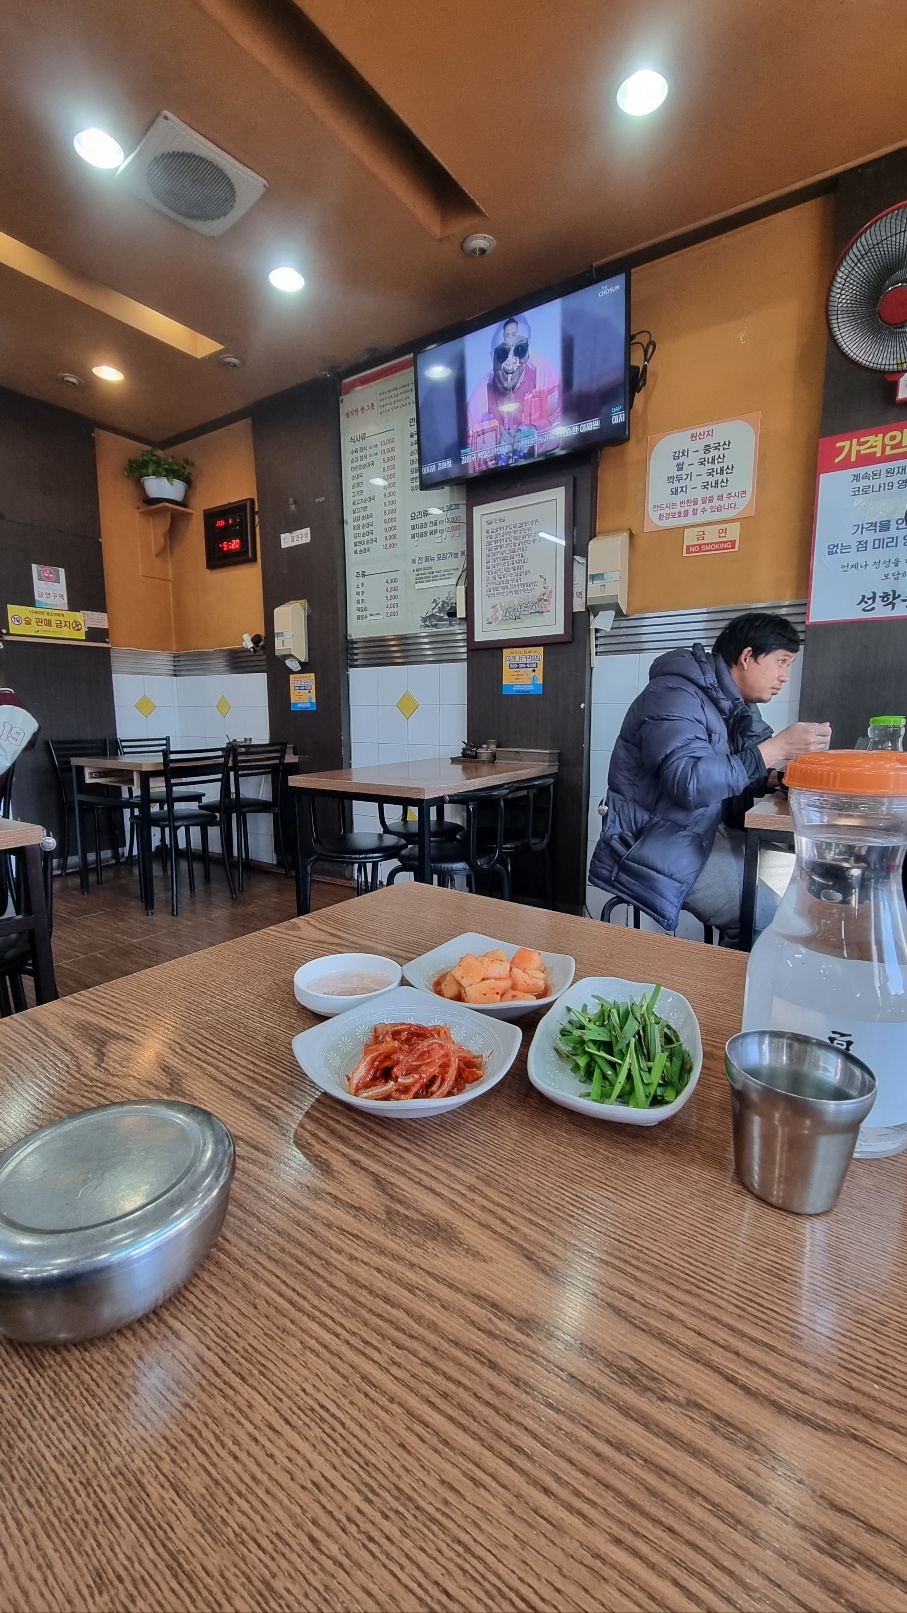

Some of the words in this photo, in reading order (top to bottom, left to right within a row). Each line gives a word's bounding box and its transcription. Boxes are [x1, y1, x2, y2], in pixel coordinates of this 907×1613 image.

[598, 284, 620, 297] CHOSUN
[350, 432, 366, 443] 식사류
[690, 429, 714, 442] 원산지
[672, 448, 689, 461] 김치
[702, 439, 731, 454] 중국산
[675, 461, 684, 472] 쌀
[697, 453, 726, 467] 국내산
[666, 472, 692, 484] 깍두기
[706, 464, 734, 477] 국내산
[850, 469, 882, 483] 계속된
[670, 485, 688, 496] 돼지
[701, 477, 729, 491] 국내산
[850, 481, 894, 497] 코로나19
[652, 501, 677, 512] 안드시는
[679, 497, 699, 508] 반찬을
[701, 494, 714, 505] 말씀
[716, 493, 724, 502] 해
[726, 490, 747, 500] 주시면
[410, 510, 428, 521] 요리류
[658, 509, 689, 521] 환경보호를
[691, 508, 698, 516] 할
[709, 502, 739, 513] 있습니다.
[852, 519, 891, 536] 가격을
[701, 541, 732, 551] SMOKING
[827, 542, 852, 556] 없는
[856, 540, 868, 552] 점
[872, 535, 898, 550] 미리
[841, 560, 869, 572] 언제나
[872, 558, 901, 570] 정성을
[355, 571, 366, 579] 주류
[37, 590, 64, 600] 금연구역
[24, 616, 32, 626] 술
[35, 617, 52, 627] 판매
[55, 620, 71, 629] 금지
[0, 721, 26, 746] 19
